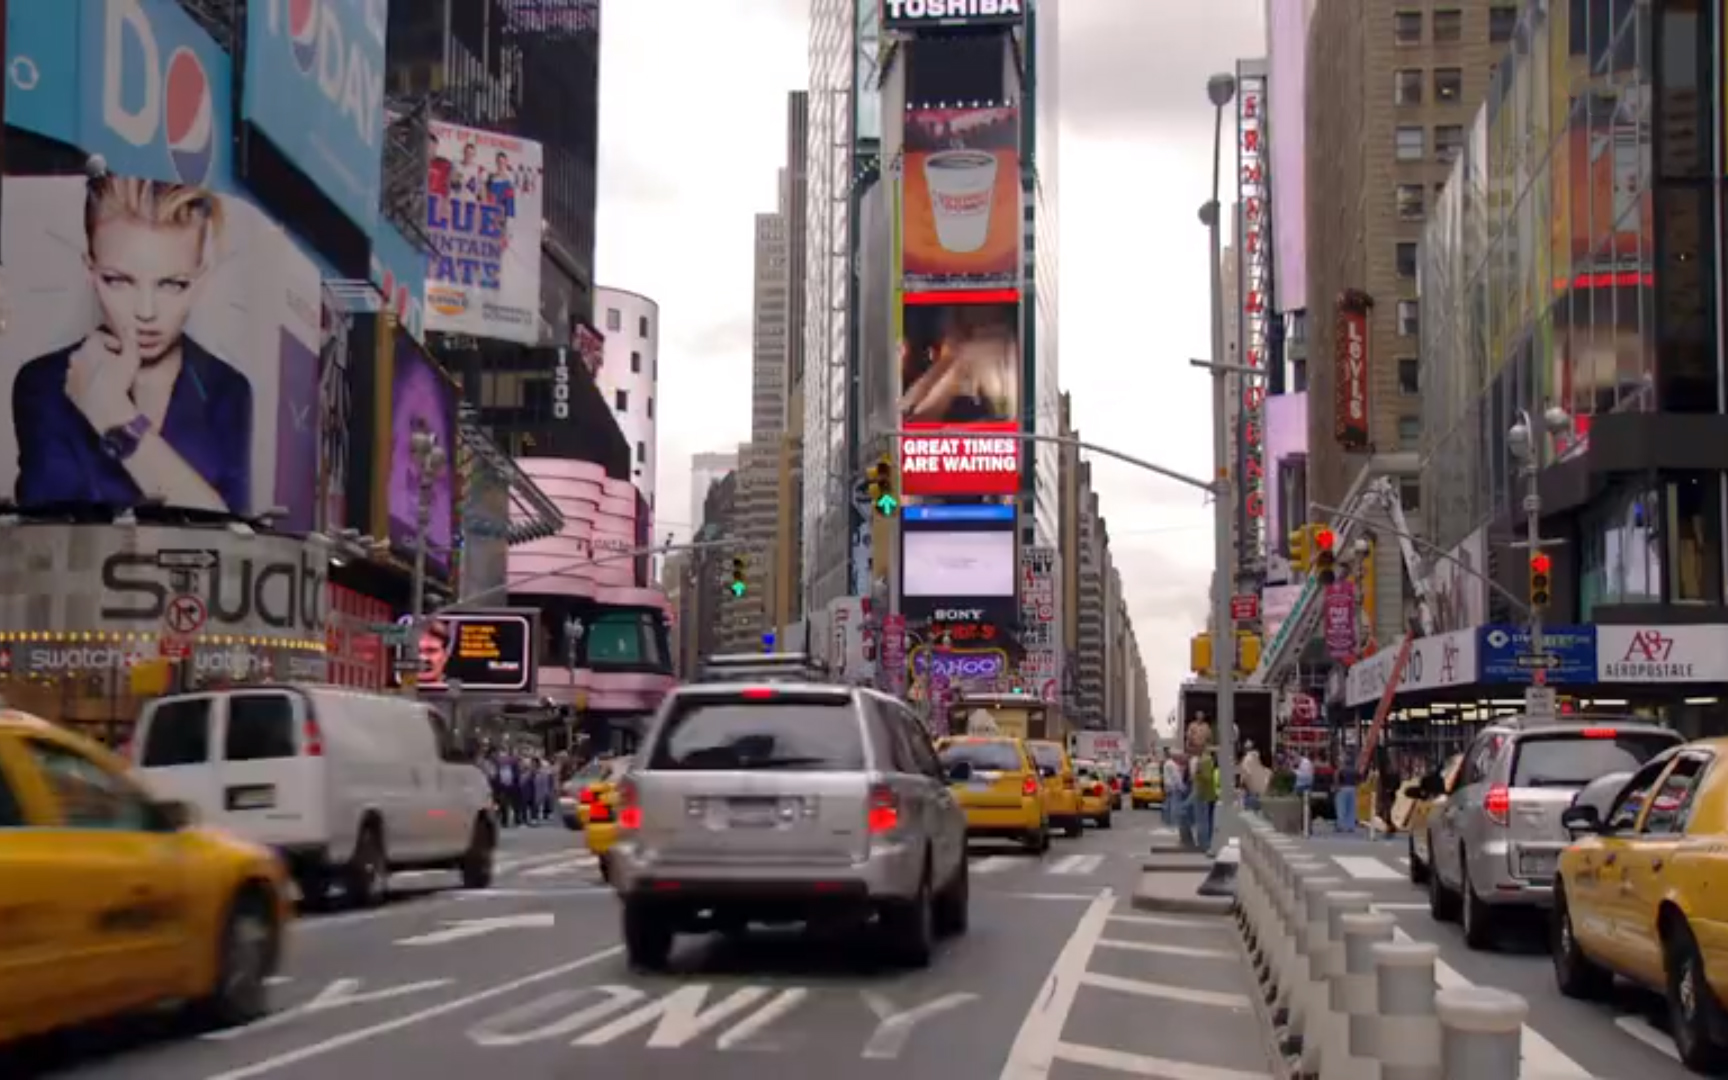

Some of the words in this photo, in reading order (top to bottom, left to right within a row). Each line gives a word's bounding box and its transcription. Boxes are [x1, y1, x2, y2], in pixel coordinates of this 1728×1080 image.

[886, 0, 1021, 18] TOSHIBA
[904, 438, 959, 455] GREAT
[962, 438, 1016, 455] TIMES
[904, 456, 939, 472] ARE
[943, 456, 1016, 472] WAITING
[934, 608, 984, 620] SONY
[466, 984, 980, 1060] ONLY
